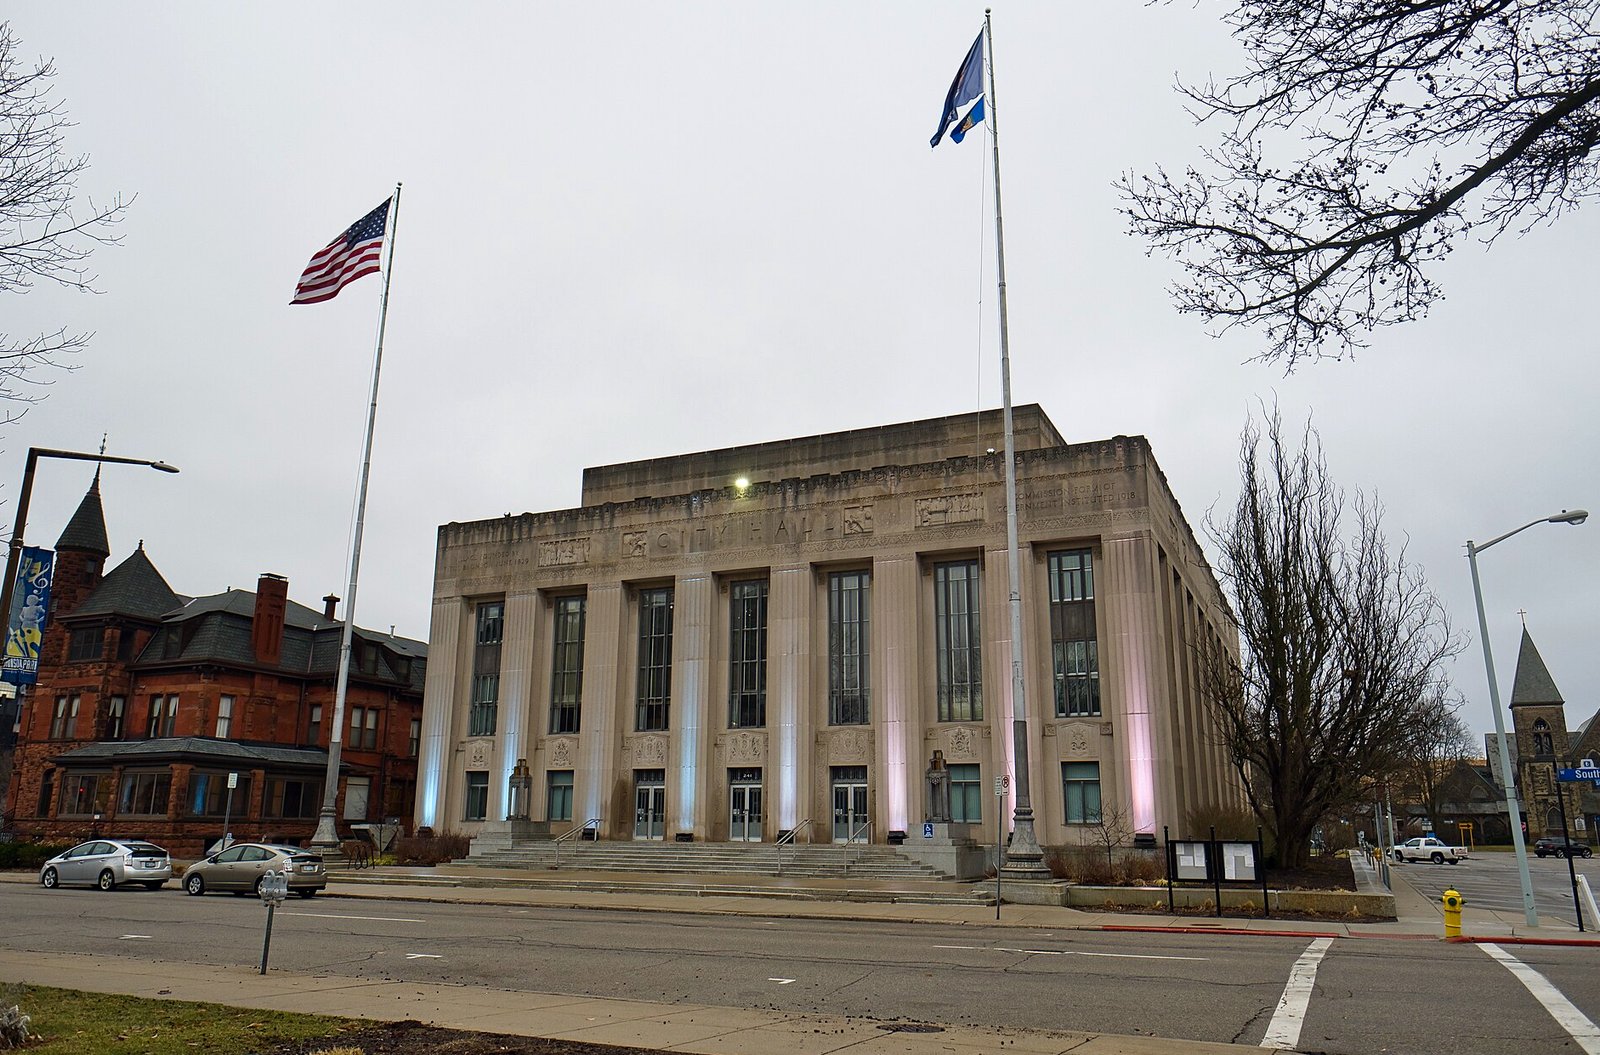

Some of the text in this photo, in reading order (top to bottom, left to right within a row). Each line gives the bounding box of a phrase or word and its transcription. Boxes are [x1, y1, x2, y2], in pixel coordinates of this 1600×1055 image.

[996, 499, 1058, 514] GOERNMENT
[1118, 490, 1136, 502] 1918
[1015, 488, 1069, 500] OMMISSION
[1103, 481, 1116, 490] OF
[657, 513, 836, 549] CITY HALL
